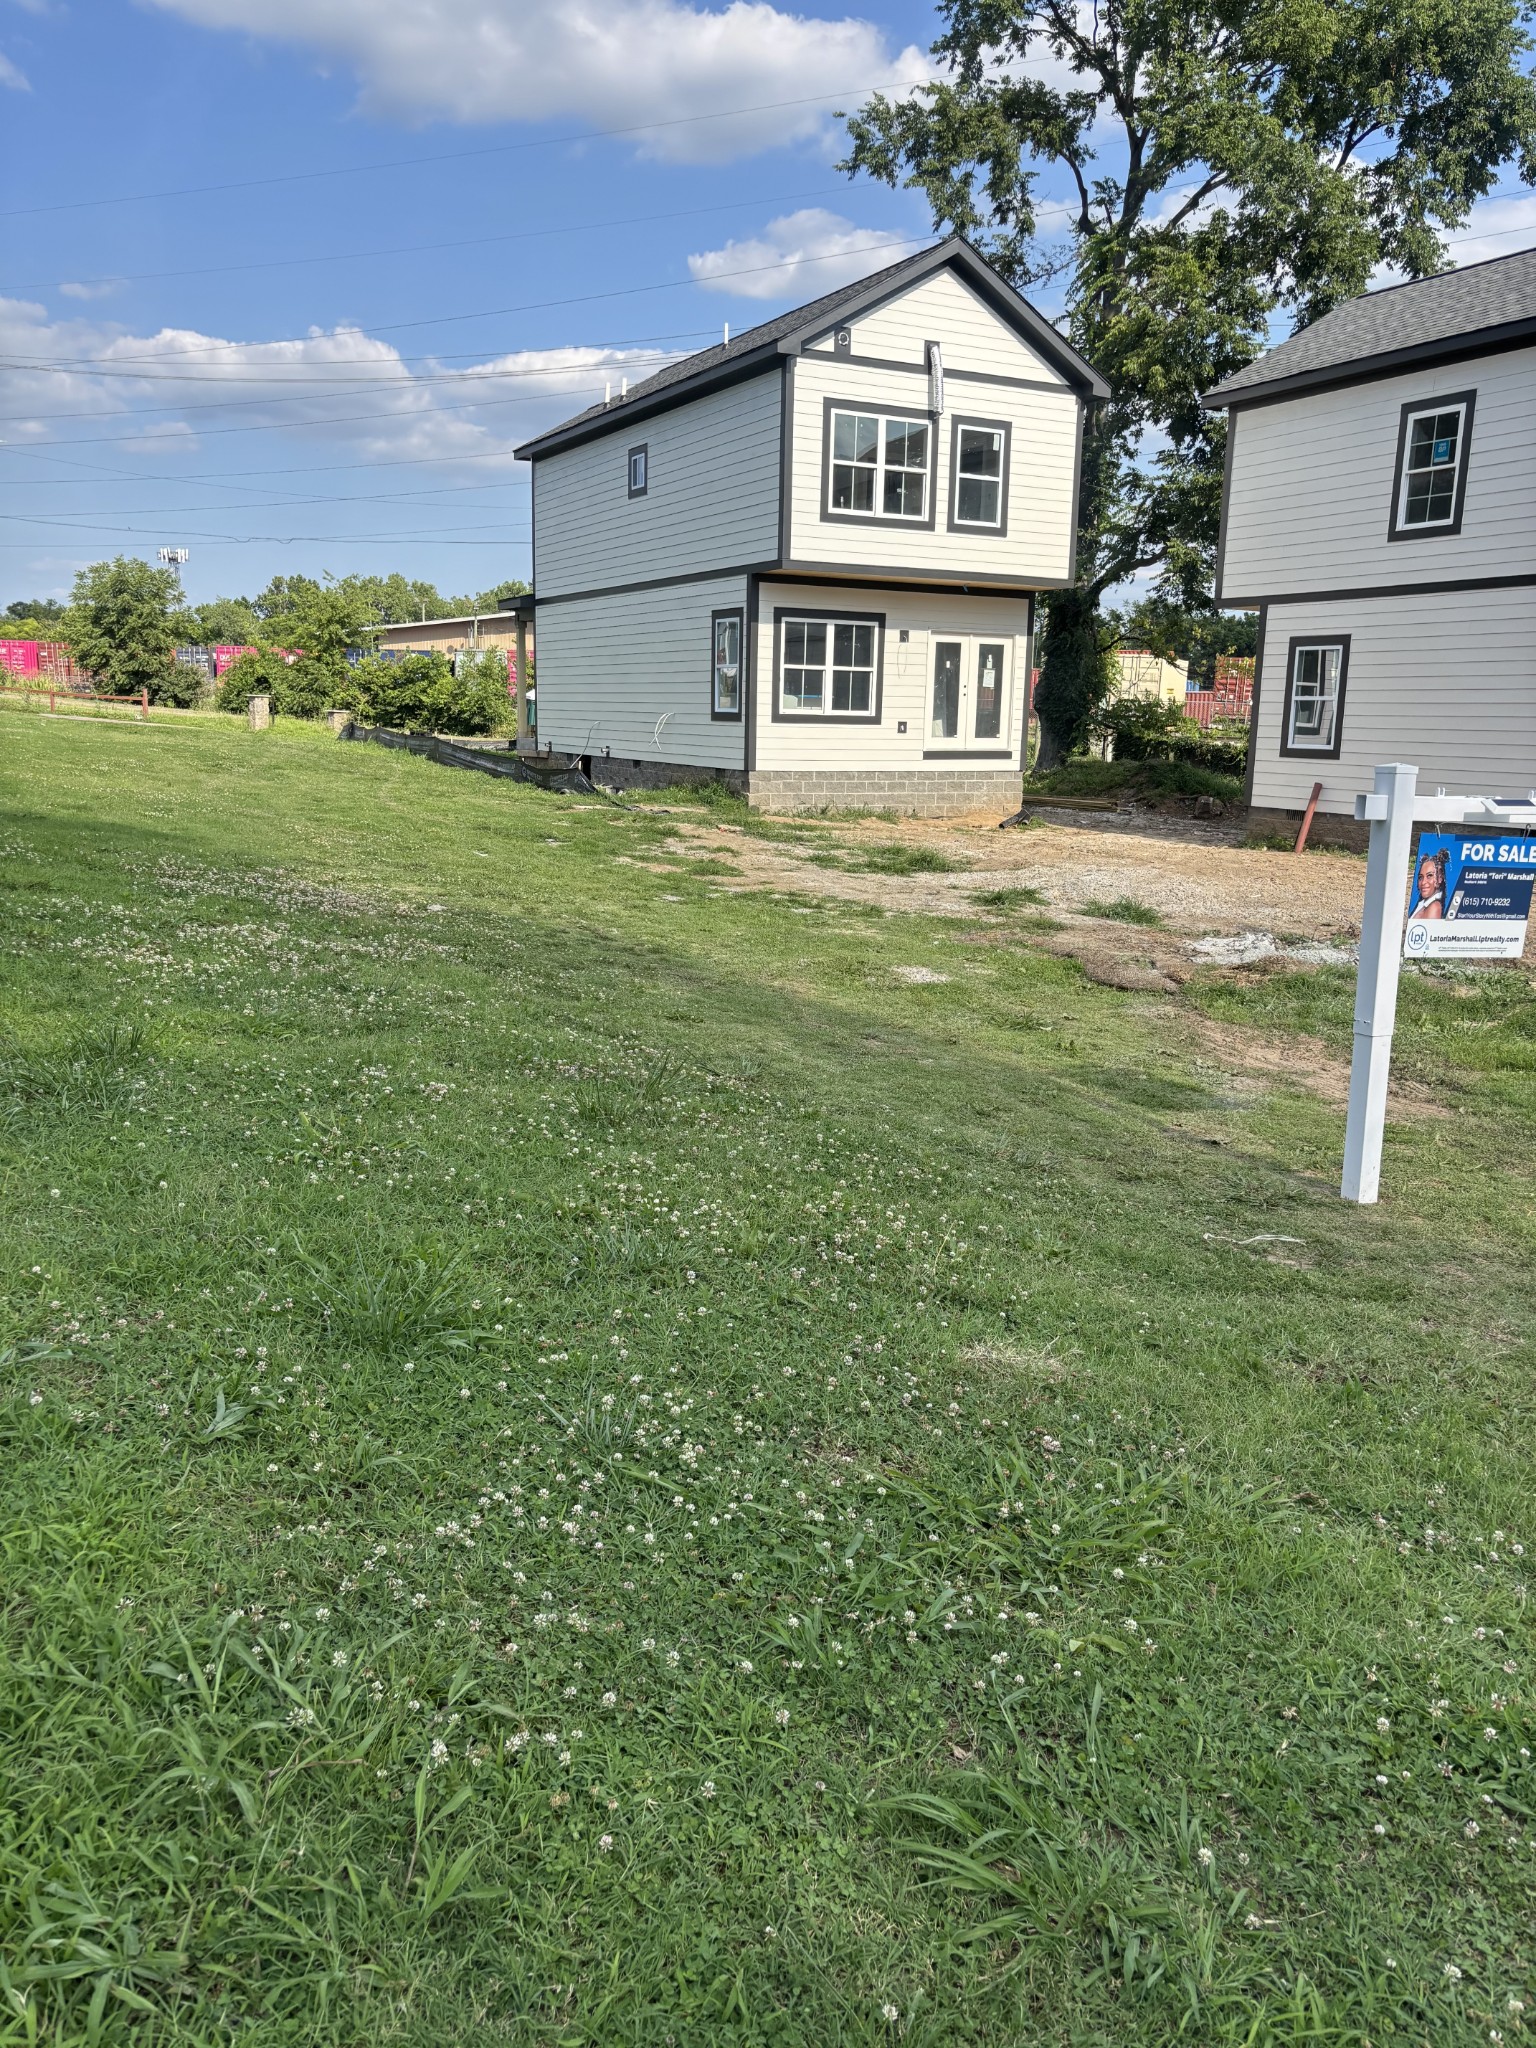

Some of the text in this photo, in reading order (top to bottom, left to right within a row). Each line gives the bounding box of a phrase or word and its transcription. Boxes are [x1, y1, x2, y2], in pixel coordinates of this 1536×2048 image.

[1461, 843, 1536, 863] FOR SALE
[1465, 872, 1535, 881] Latoria "Tori" Marshall
[1462, 897, 1511, 907] (615) 710-9232
[1410, 931, 1424, 945] lpt
